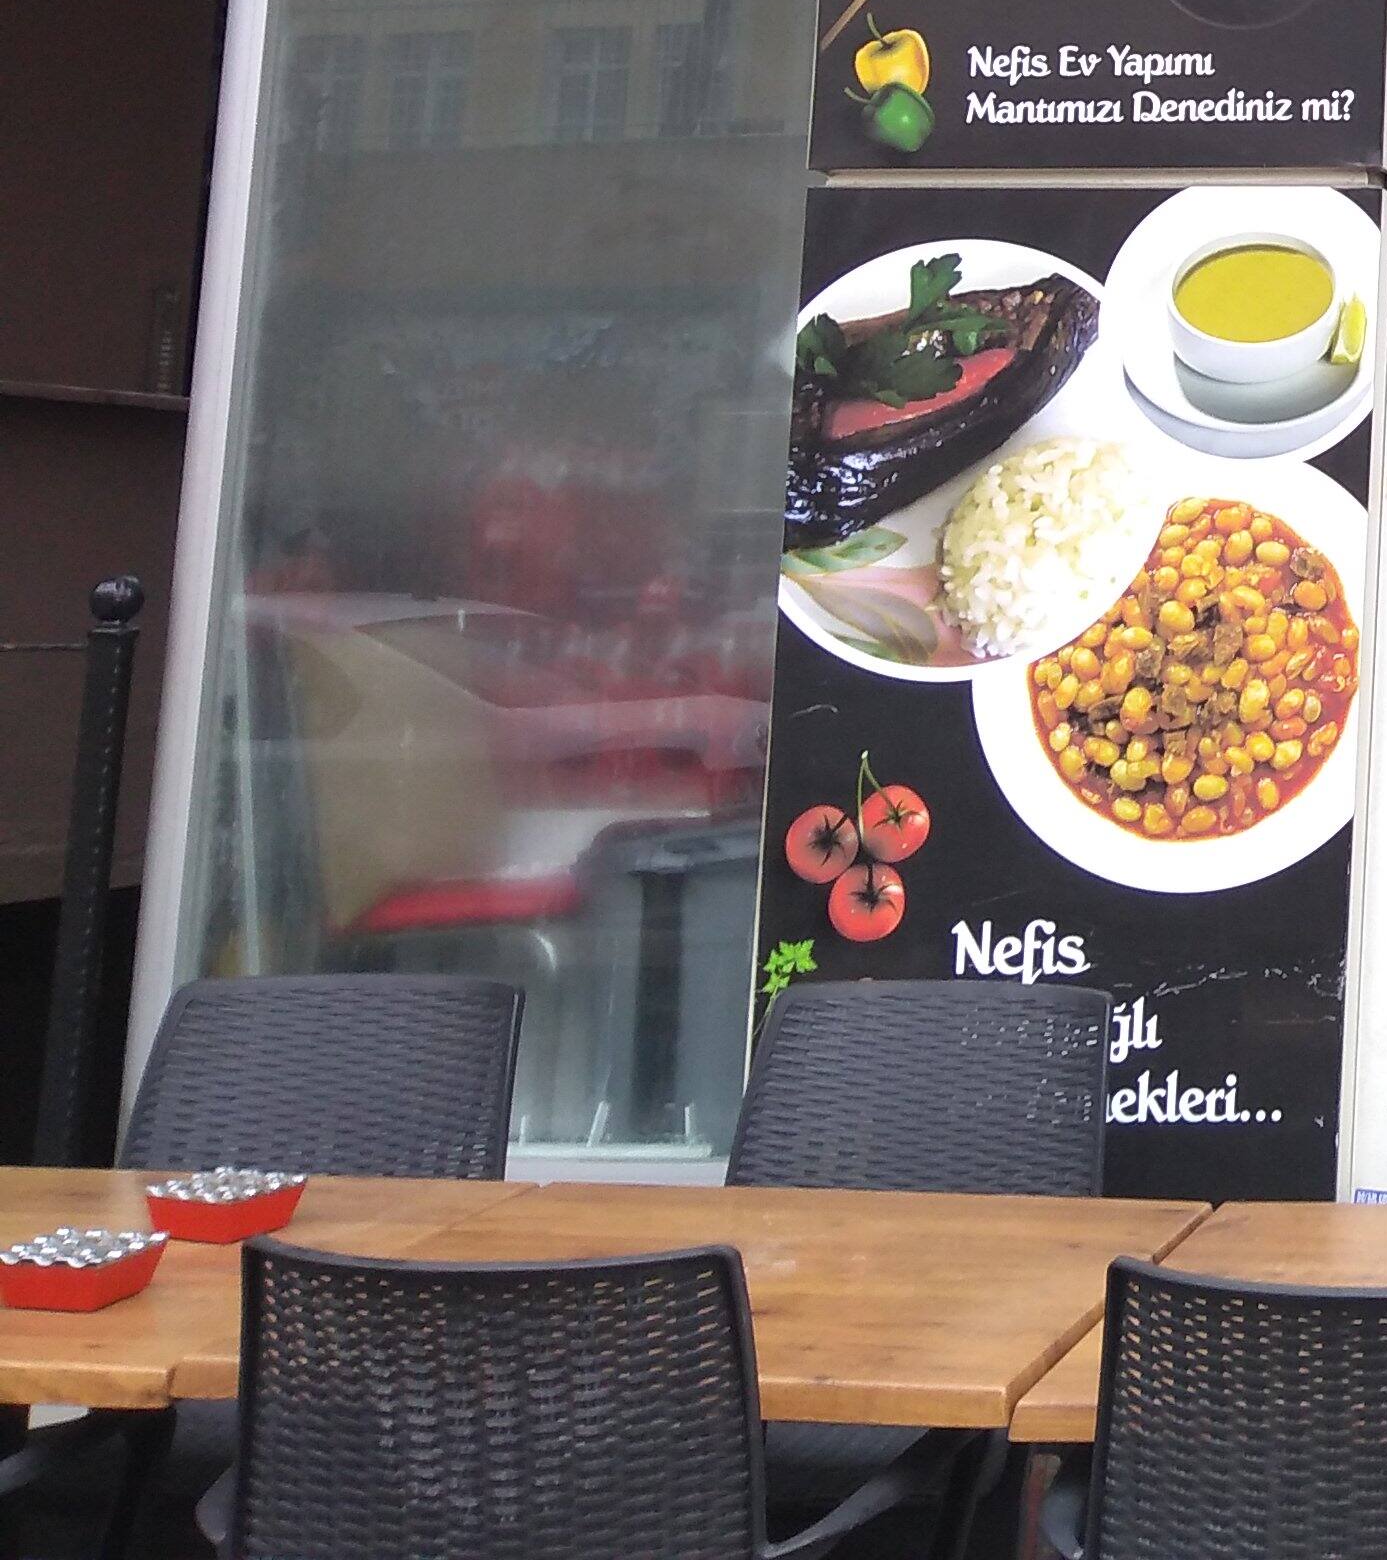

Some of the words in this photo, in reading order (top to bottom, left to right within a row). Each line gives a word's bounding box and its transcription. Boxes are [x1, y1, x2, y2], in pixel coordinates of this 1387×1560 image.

[967, 45, 1051, 87] Nefis
[1058, 45, 1102, 78] Ev
[1106, 44, 1215, 84] Yapımı
[965, 92, 1124, 124] Mantımızı
[1131, 88, 1293, 123] Denediniz
[1301, 89, 1356, 122] mi?
[951, 920, 1092, 985] Nefis
[1105, 1069, 1282, 1124] ekleri...
